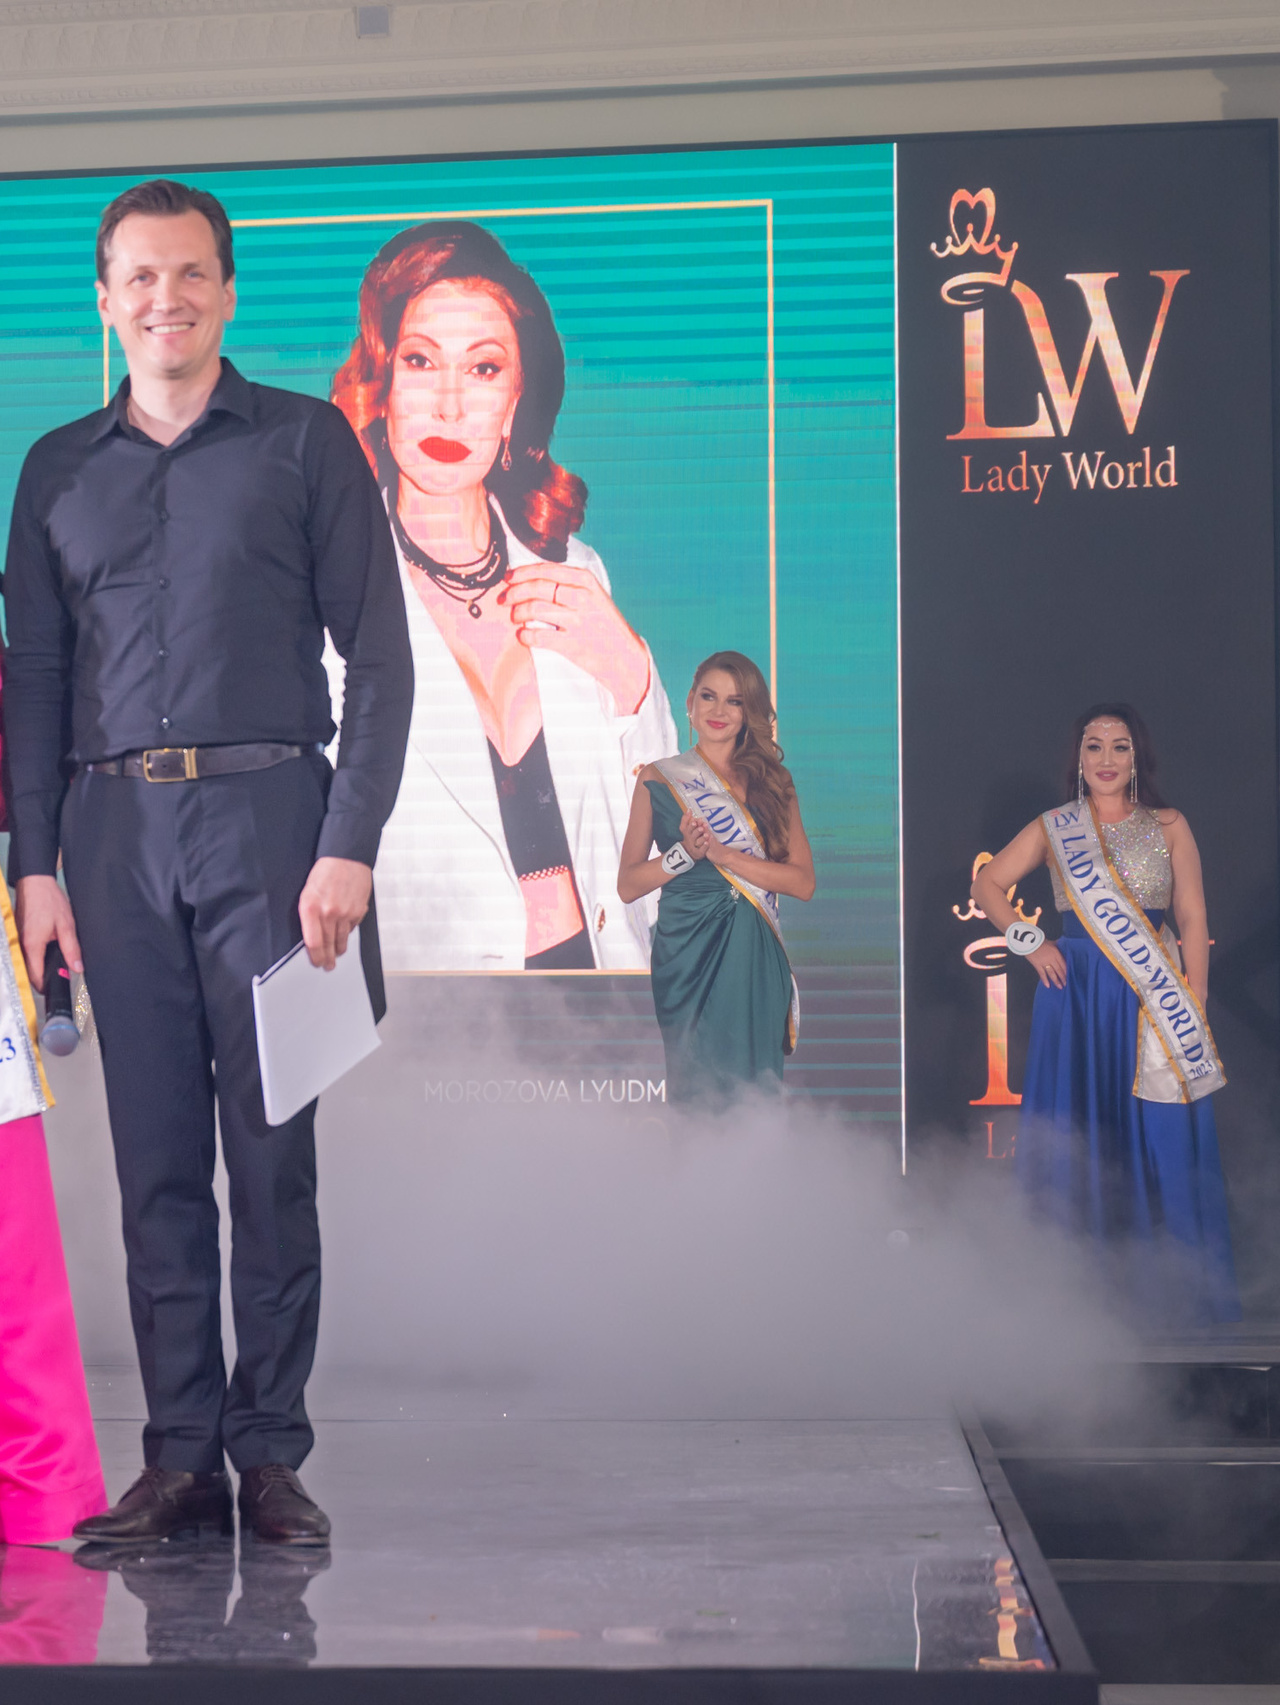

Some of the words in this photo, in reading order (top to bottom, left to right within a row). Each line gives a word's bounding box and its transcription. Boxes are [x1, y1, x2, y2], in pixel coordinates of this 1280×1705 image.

[942, 269, 1191, 440] LW
[960, 450, 1053, 505] Lady
[1061, 445, 1179, 490] World
[695, 792, 746, 846] LADY
[666, 849, 688, 871] 13
[1013, 929, 1036, 944] 5
[1061, 834, 1106, 893] LADY
[1093, 898, 1151, 965] GOLD
[1149, 967, 1205, 1063] WORLD
[1190, 1059, 1215, 1081] 2023
[423, 1079, 571, 1104] MOROZOVA
